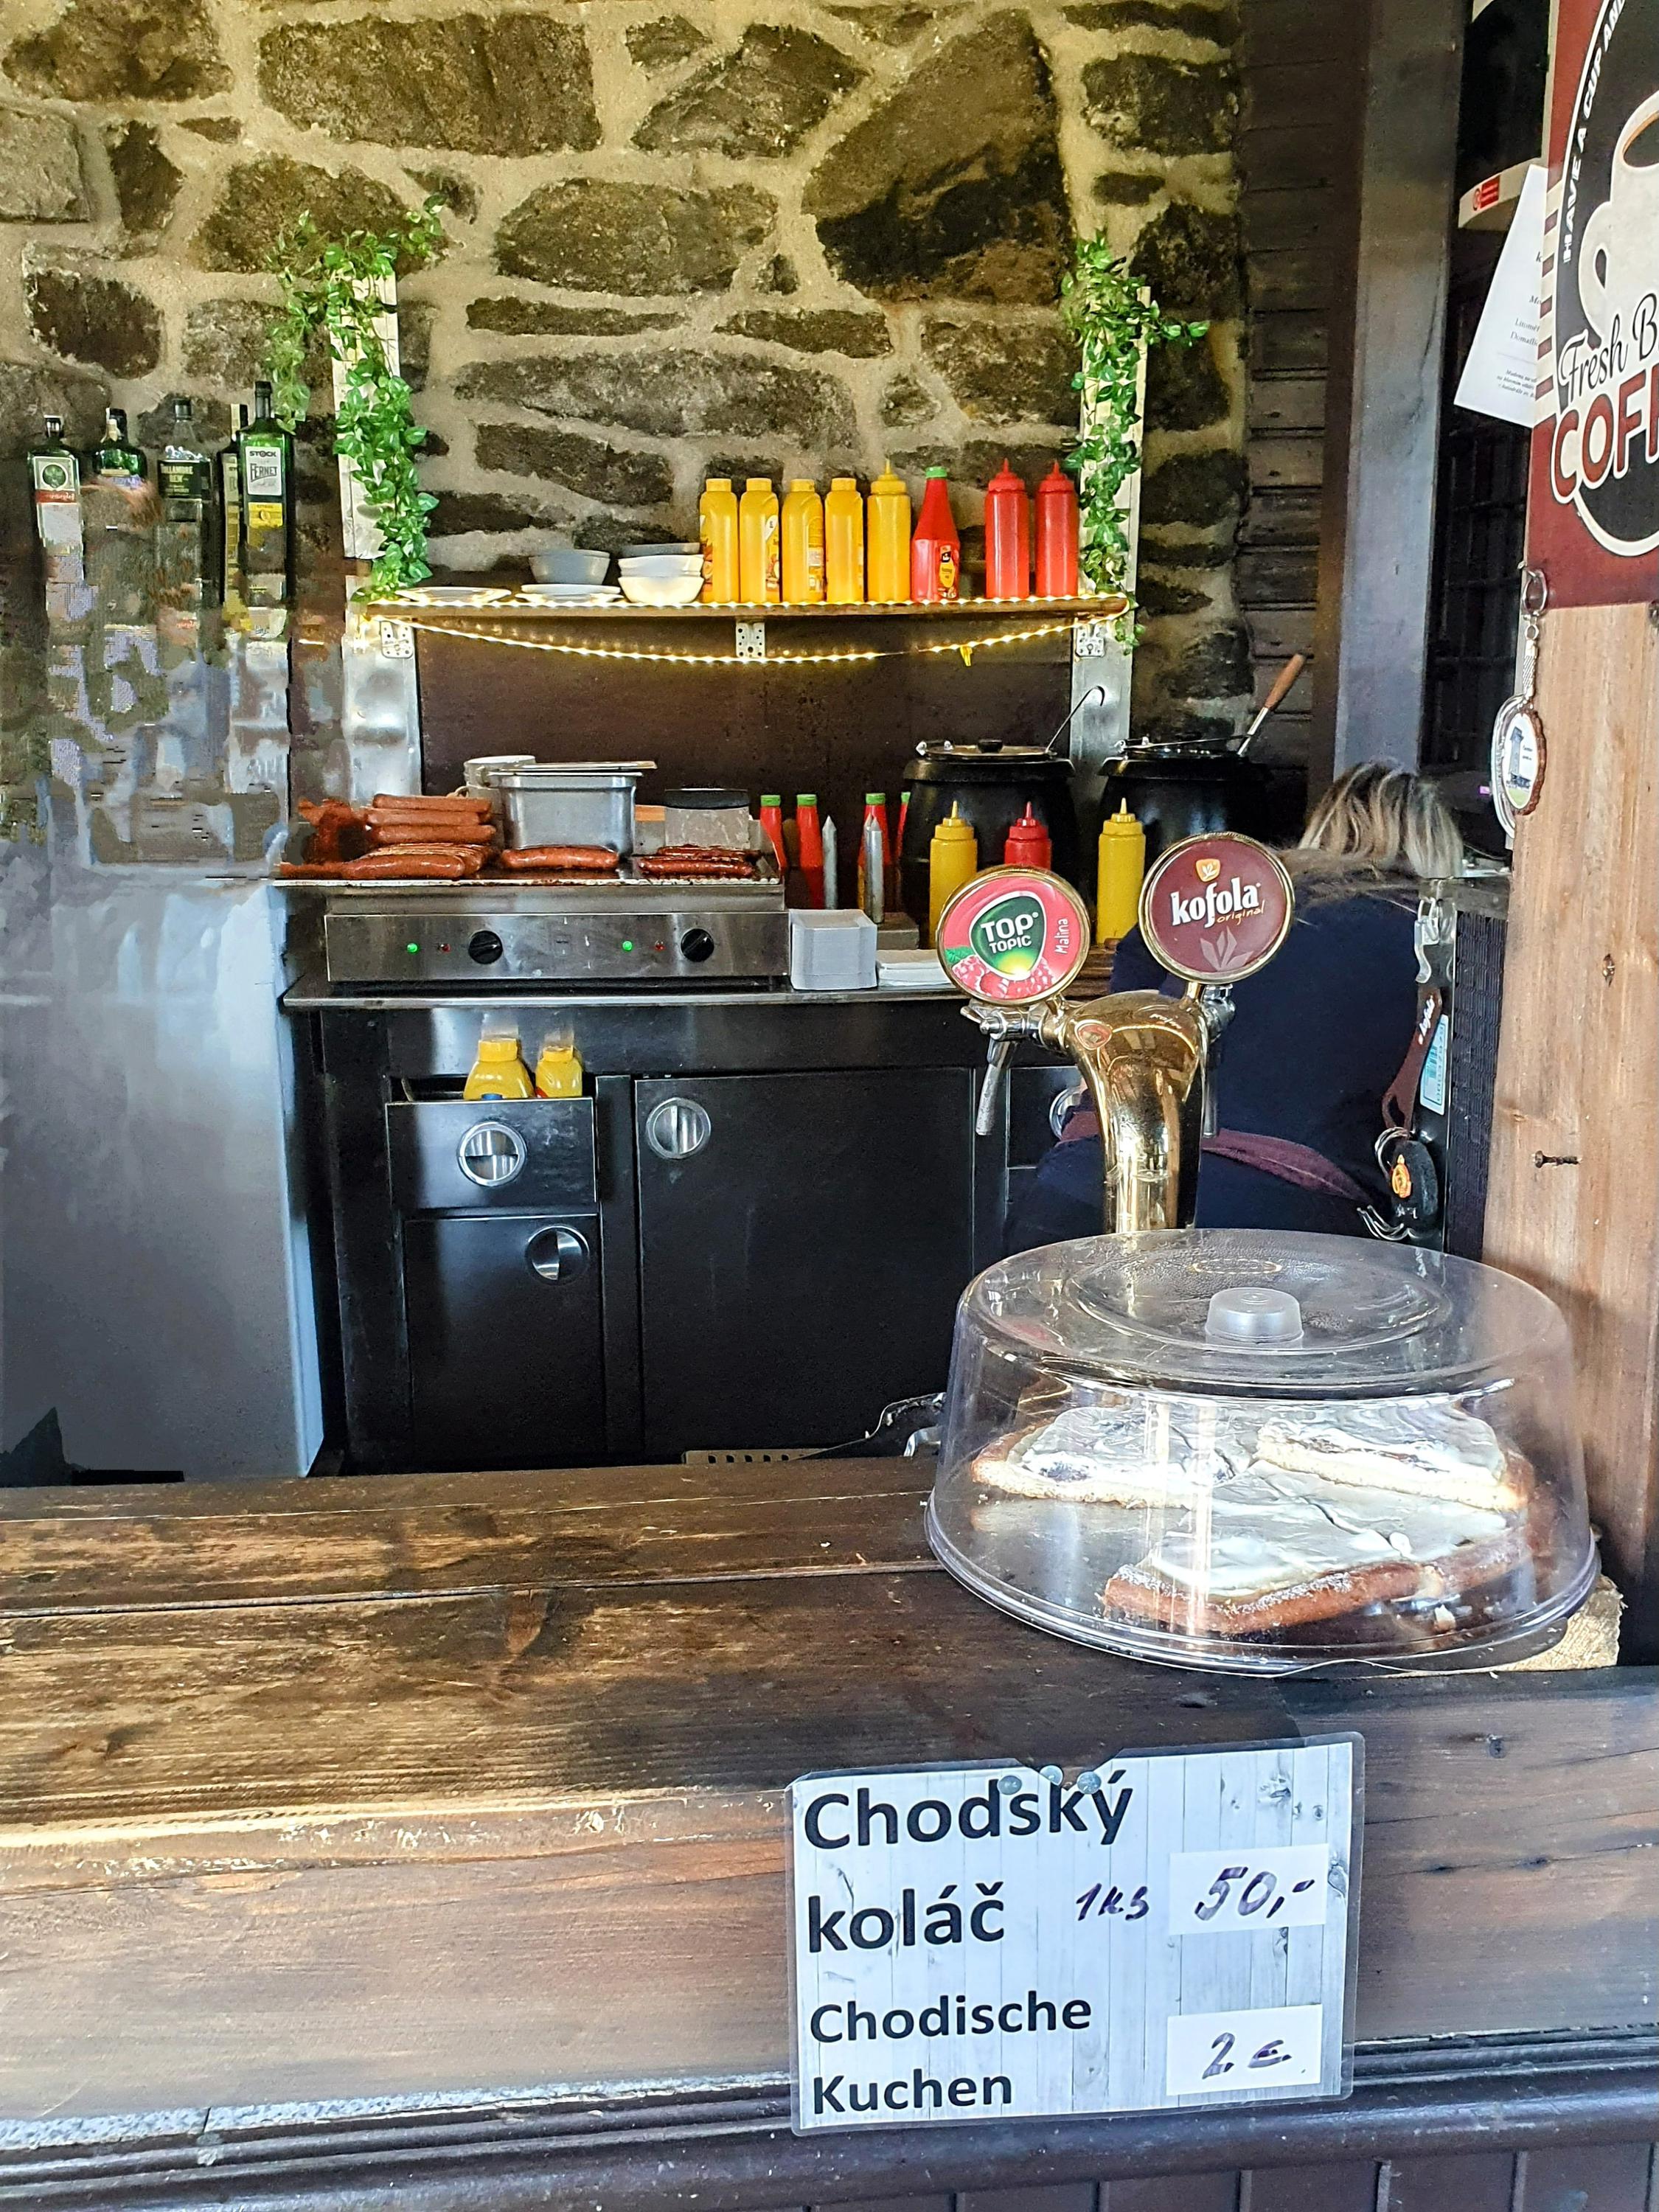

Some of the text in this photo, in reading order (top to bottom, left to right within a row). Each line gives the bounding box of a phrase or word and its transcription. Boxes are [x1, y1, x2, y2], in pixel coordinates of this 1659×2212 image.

[1563, 156, 1582, 263] HAVE
[1577, 128, 1587, 153] A
[1583, 46, 1602, 119] CUP
[1558, 313, 1629, 403] Fresh
[250, 463, 277, 482] FERNET
[1169, 877, 1259, 928] kofola
[1217, 900, 1265, 926] original
[980, 914, 1034, 943] TOP
[989, 934, 1032, 954] TOPIC
[1054, 917, 1070, 955] Malina
[804, 1769, 1133, 1849] Chodský
[807, 1881, 1004, 1953] koláč
[810, 1990, 1091, 2043] Chodische
[813, 2068, 1012, 2115] Kuchen
